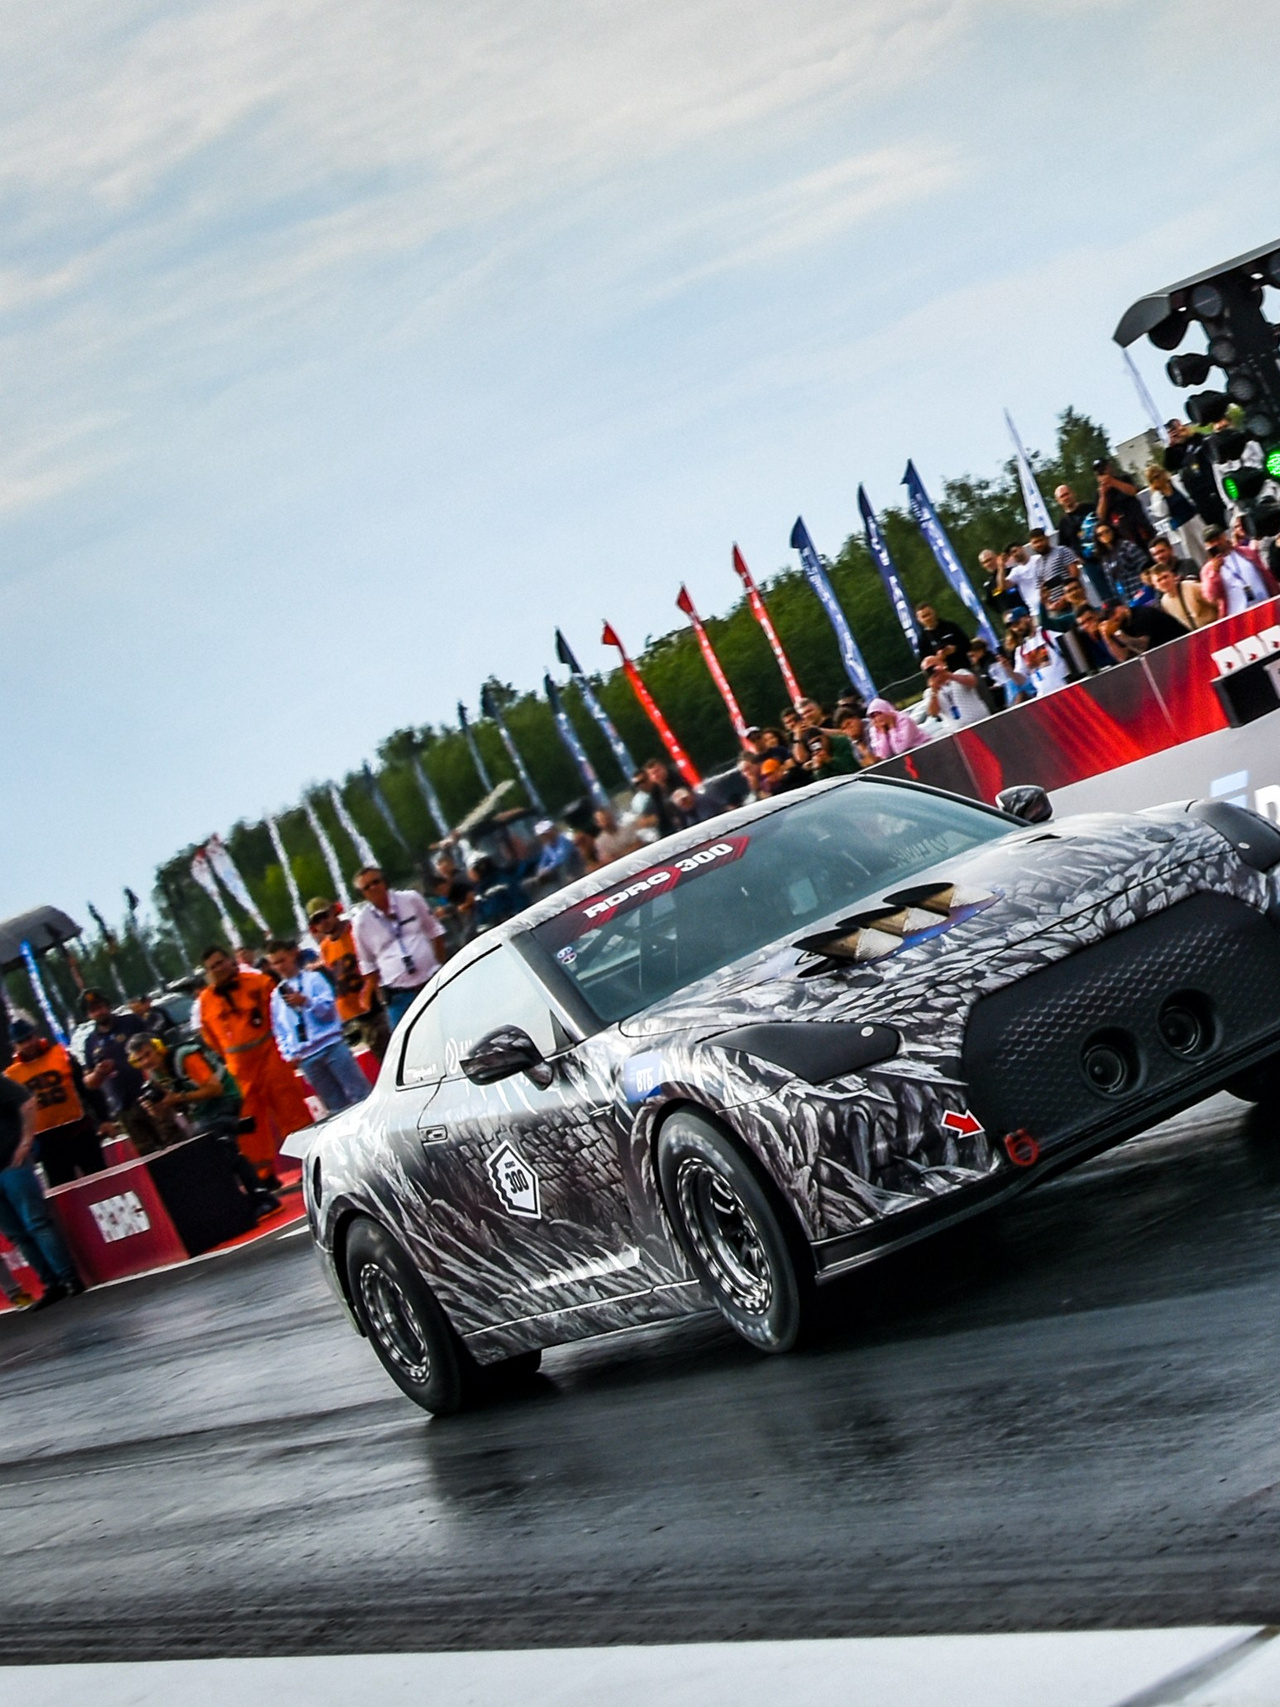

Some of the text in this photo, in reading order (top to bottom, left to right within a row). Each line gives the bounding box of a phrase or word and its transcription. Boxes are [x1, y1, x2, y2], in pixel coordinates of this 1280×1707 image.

[582, 842, 734, 919] RDRC 300
[636, 1066, 654, 1093] ВТБ
[504, 1168, 530, 1194] 300
